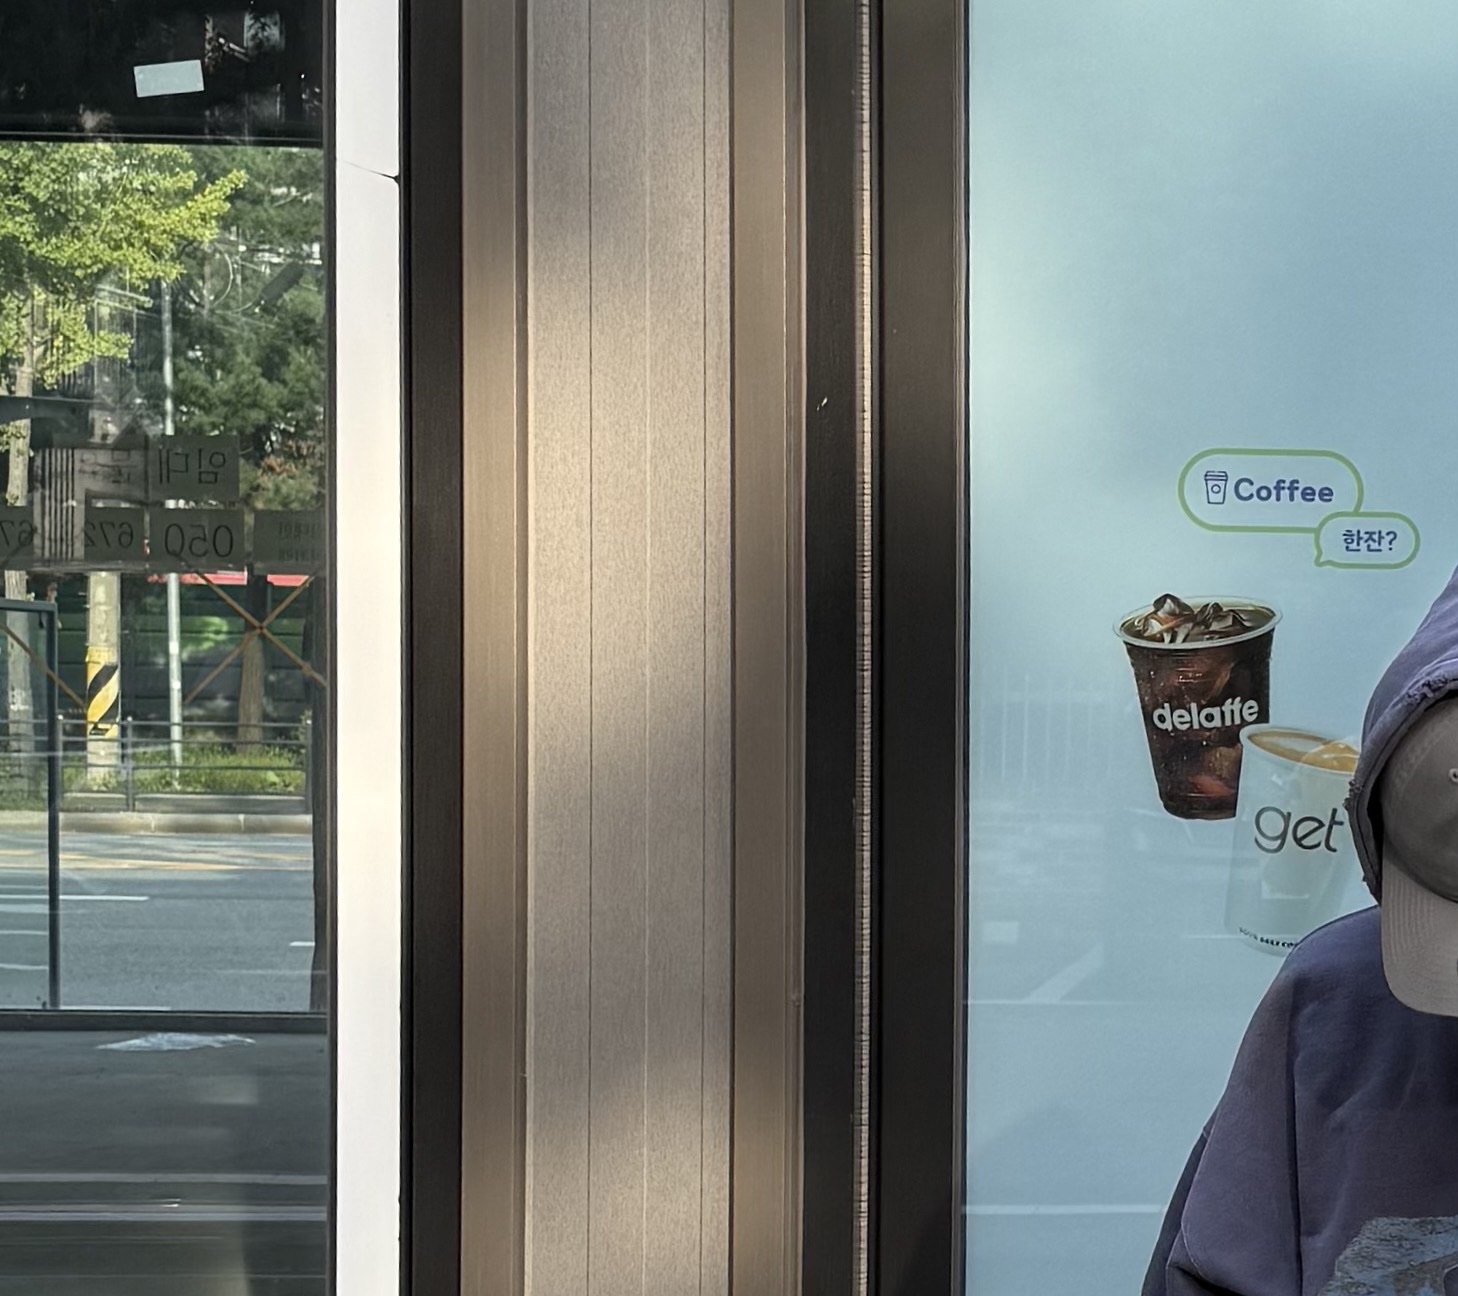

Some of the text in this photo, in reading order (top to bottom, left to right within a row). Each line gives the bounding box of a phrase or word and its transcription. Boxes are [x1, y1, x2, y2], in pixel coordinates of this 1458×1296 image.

[1233, 477, 1334, 503] Coffee
[1341, 529, 1398, 553] 한잔?
[1152, 696, 1260, 732] delaffe
[1254, 806, 1345, 854] get
